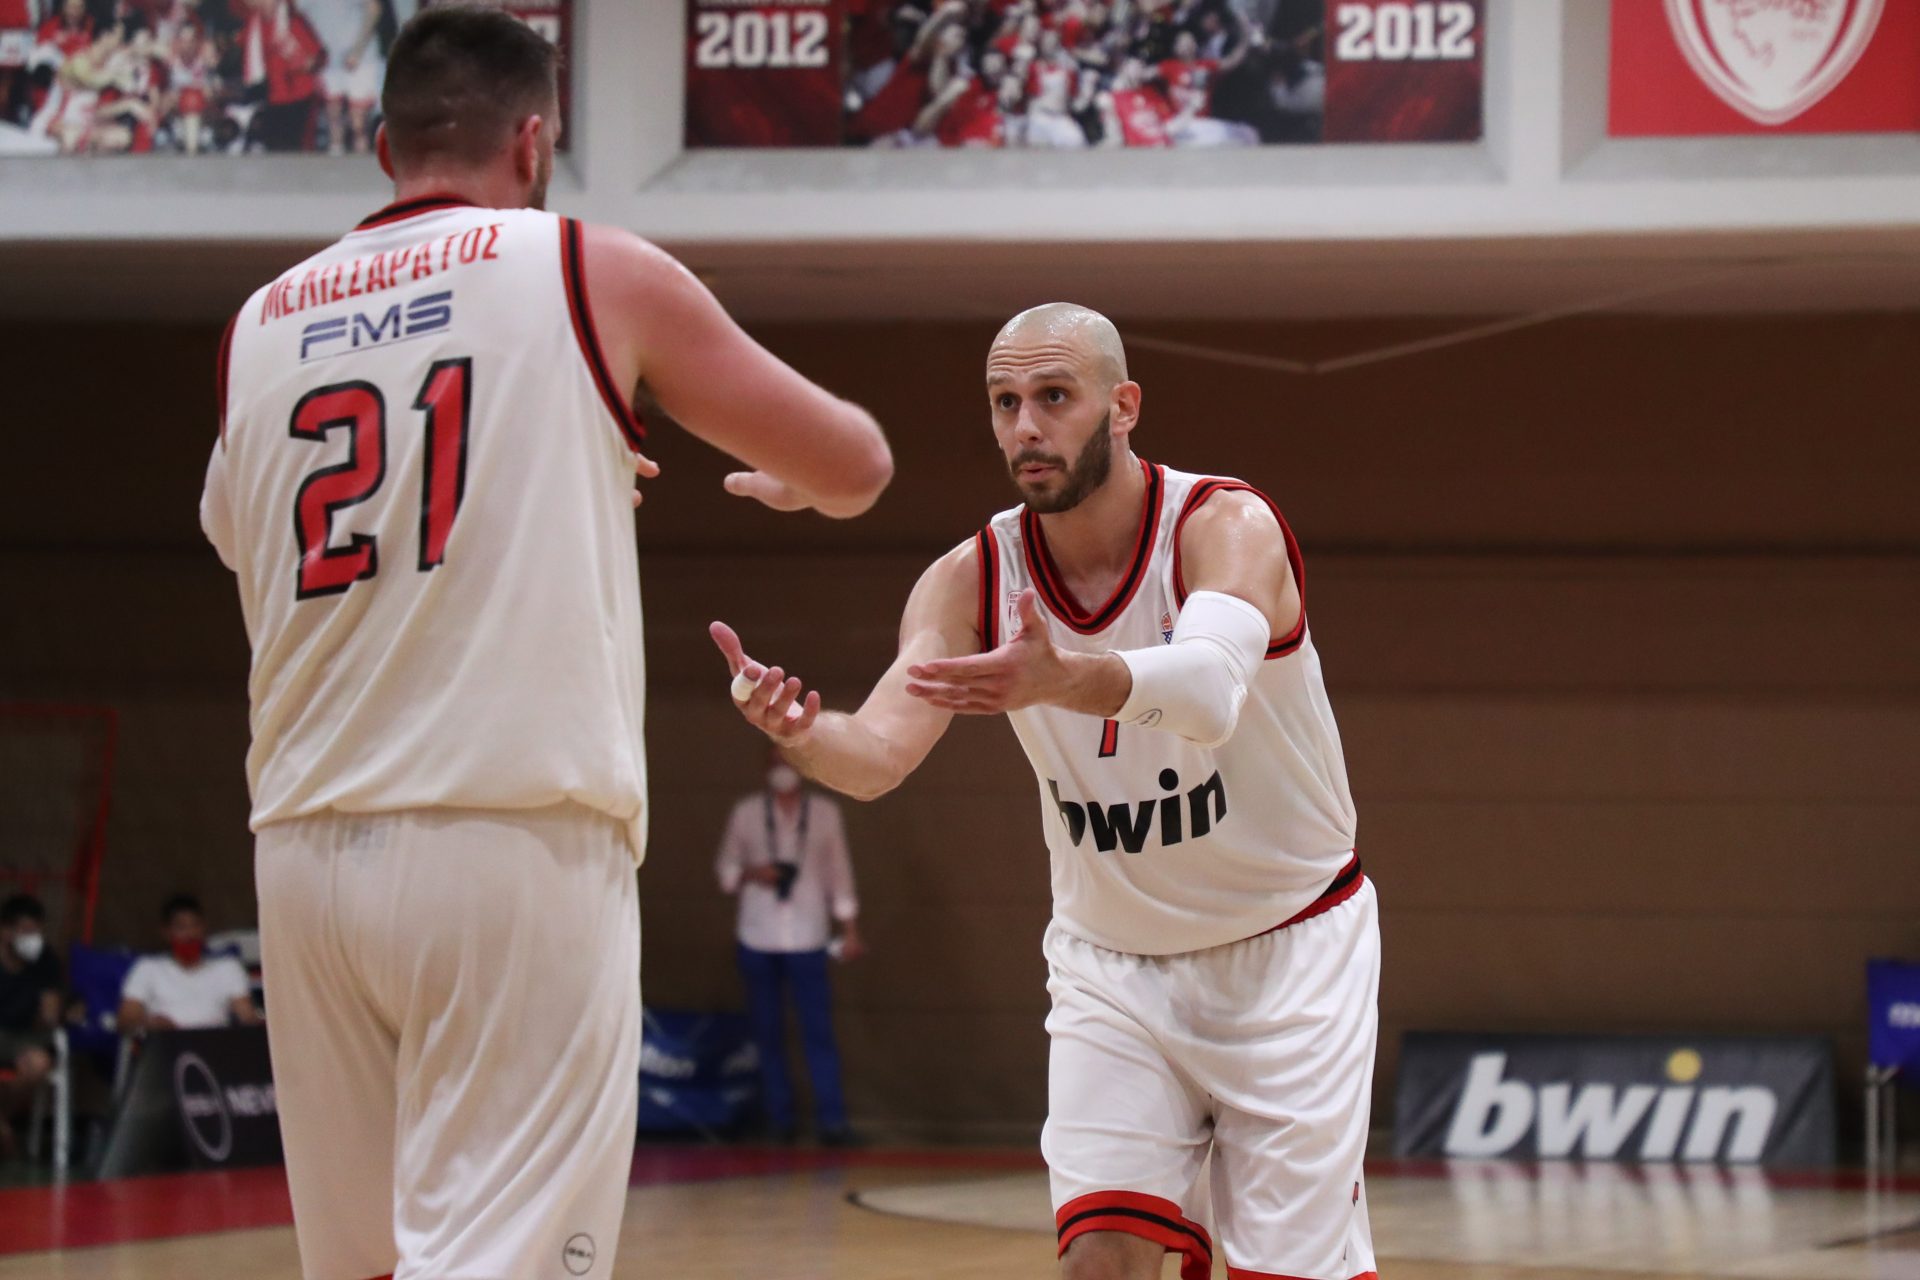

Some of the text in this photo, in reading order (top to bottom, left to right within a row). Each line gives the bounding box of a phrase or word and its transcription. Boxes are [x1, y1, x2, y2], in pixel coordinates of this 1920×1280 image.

[697, 11, 829, 68] 2012
[1337, 1, 1476, 60] 2012
[300, 289, 453, 359] FMS
[289, 356, 472, 601] 21
[1047, 768, 1227, 854] bwin
[1445, 1050, 1777, 1160] bwin
